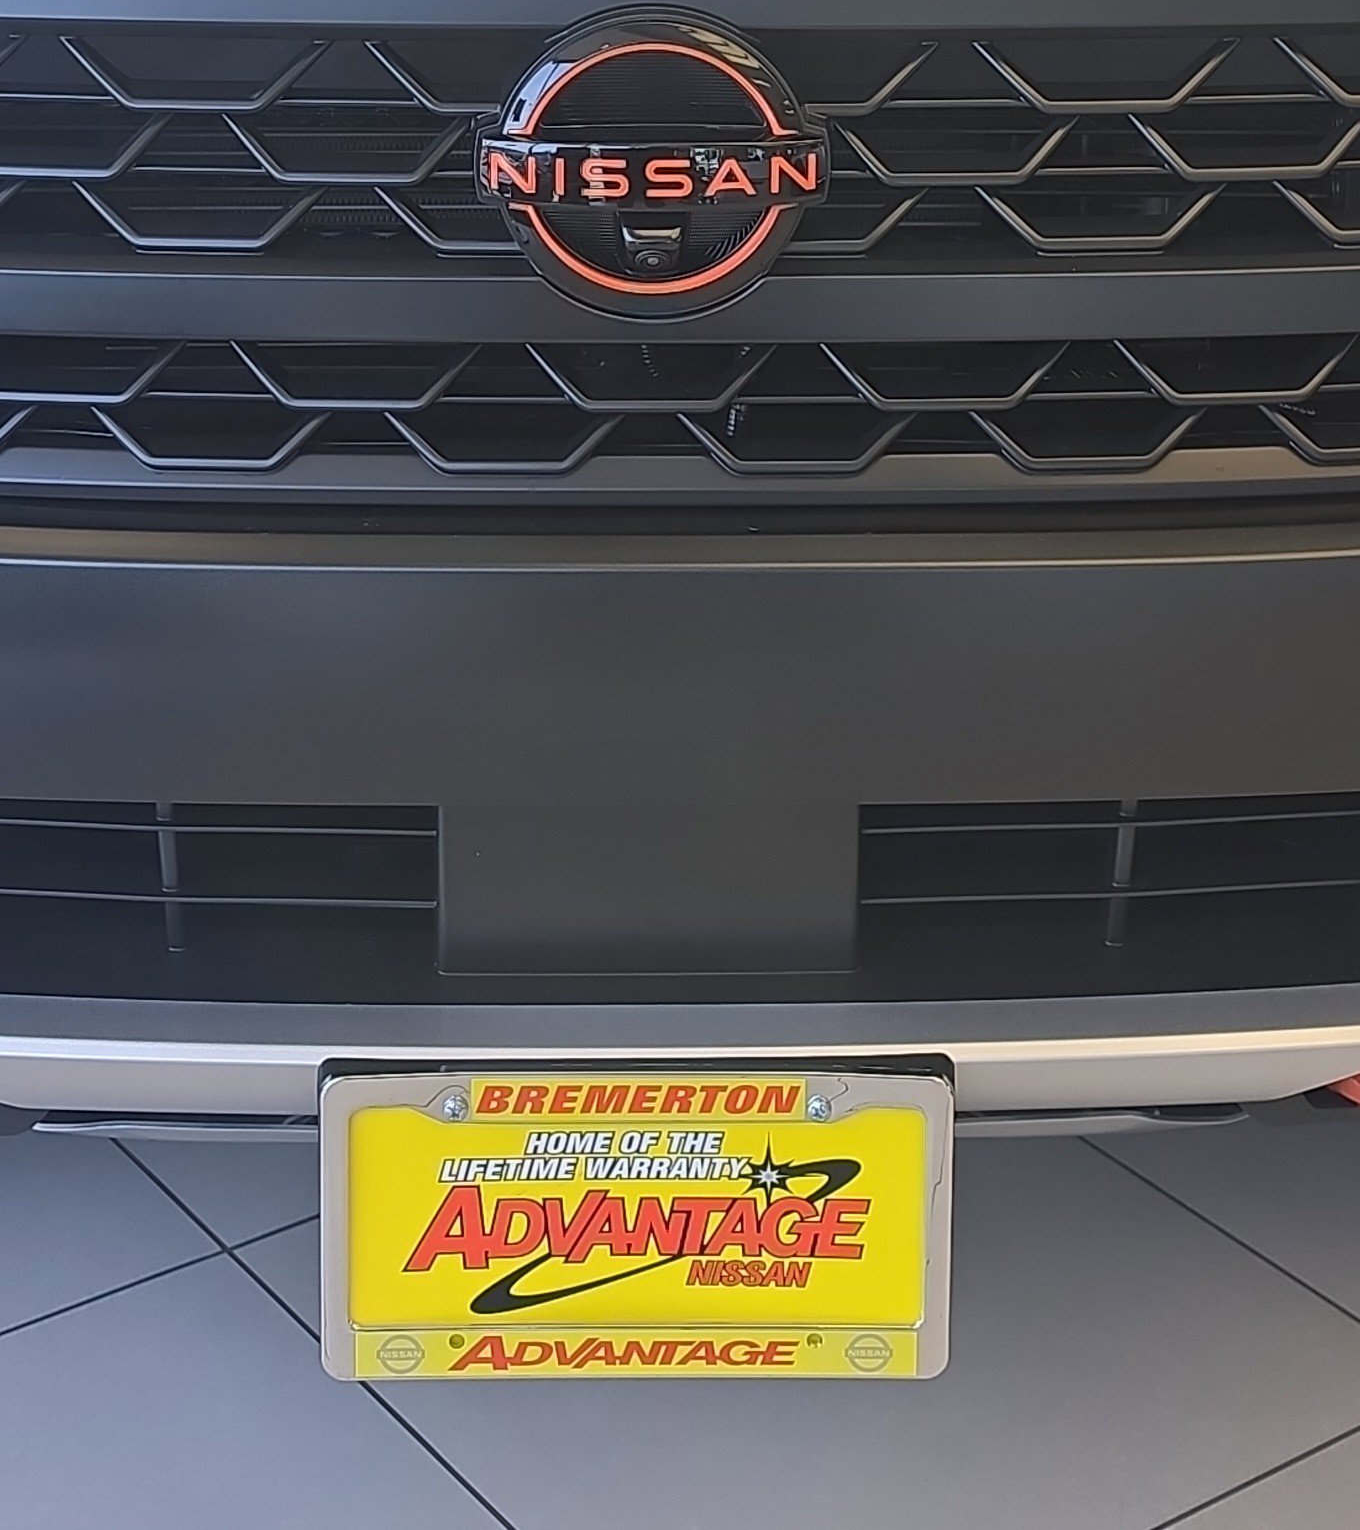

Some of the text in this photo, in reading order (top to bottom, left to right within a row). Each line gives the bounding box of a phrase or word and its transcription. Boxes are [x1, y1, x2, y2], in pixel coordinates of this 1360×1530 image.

[488, 152, 817, 198] NISSAN
[475, 1084, 802, 1115] BREMERTON
[524, 1130, 725, 1156] HOME OF THE
[438, 1156, 752, 1183] LIFETIME WARRANTY
[402, 1184, 872, 1273] ADVANTAGE
[686, 1260, 812, 1288] NISSAN
[380, 1334, 890, 1371] NISSAN ADVANTAGE NISSAN
